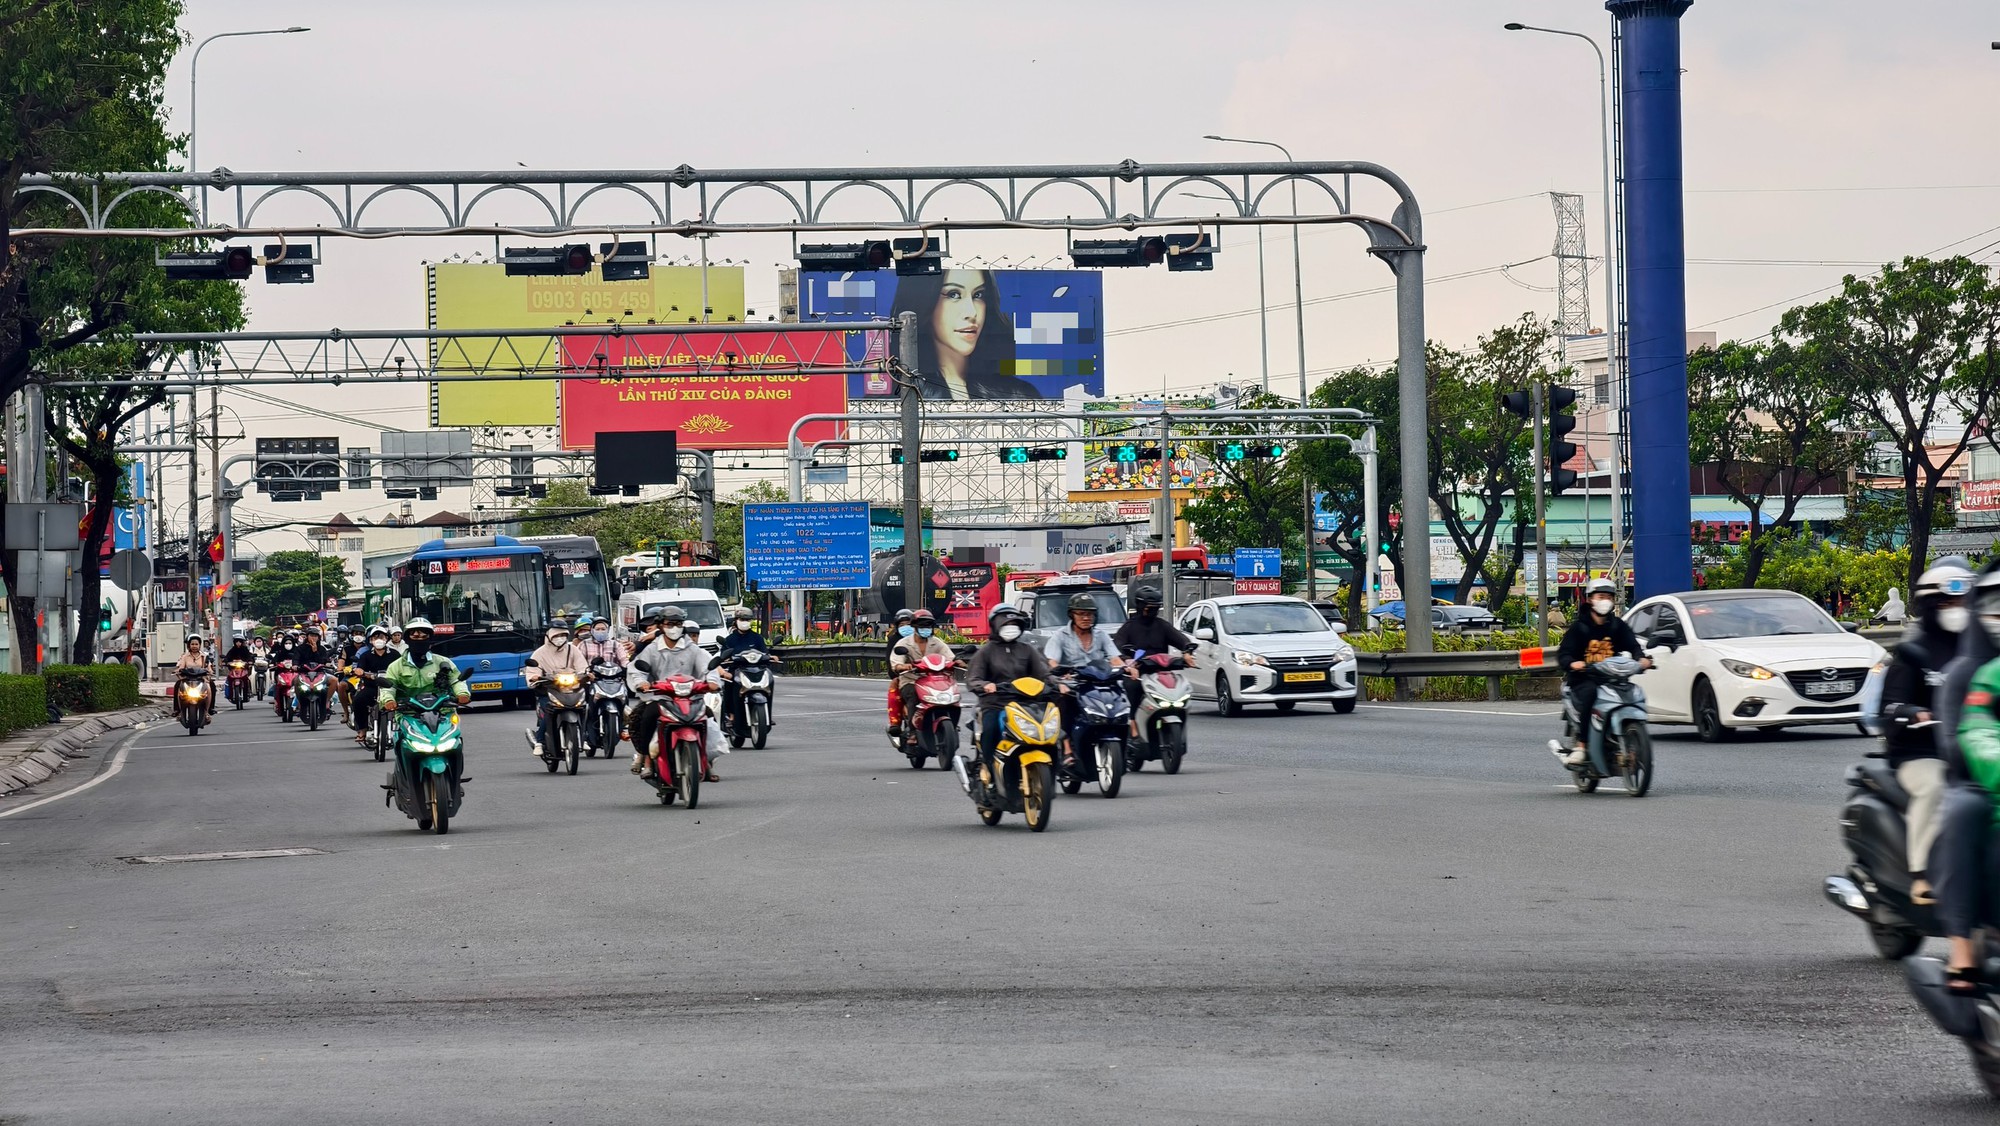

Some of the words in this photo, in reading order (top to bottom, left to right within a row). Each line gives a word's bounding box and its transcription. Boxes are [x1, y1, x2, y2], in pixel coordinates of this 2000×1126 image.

[532, 290, 576, 308] 0903
[581, 290, 612, 308] 605
[618, 291, 650, 310] 459
[619, 386, 646, 401] LẦN
[650, 388, 677, 400] THỨ
[680, 390, 706, 400] XIV
[710, 386, 740, 400] CỦA
[745, 386, 792, 400] ĐẢNG!
[1008, 448, 1026, 462] 26
[1119, 446, 1136, 460] 26
[1226, 445, 1244, 460] 26
[1075, 543, 1090, 555] QUY
[1092, 544, 1102, 554] GS
[431, 563, 441, 573] 84
[1558, 571, 1587, 584] ƠM
[1237, 582, 1248, 591] CHÚ
[1249, 582, 1253, 591] Ý
[1253, 583, 1268, 591] QUAN
[1268, 582, 1279, 591] SÁT
